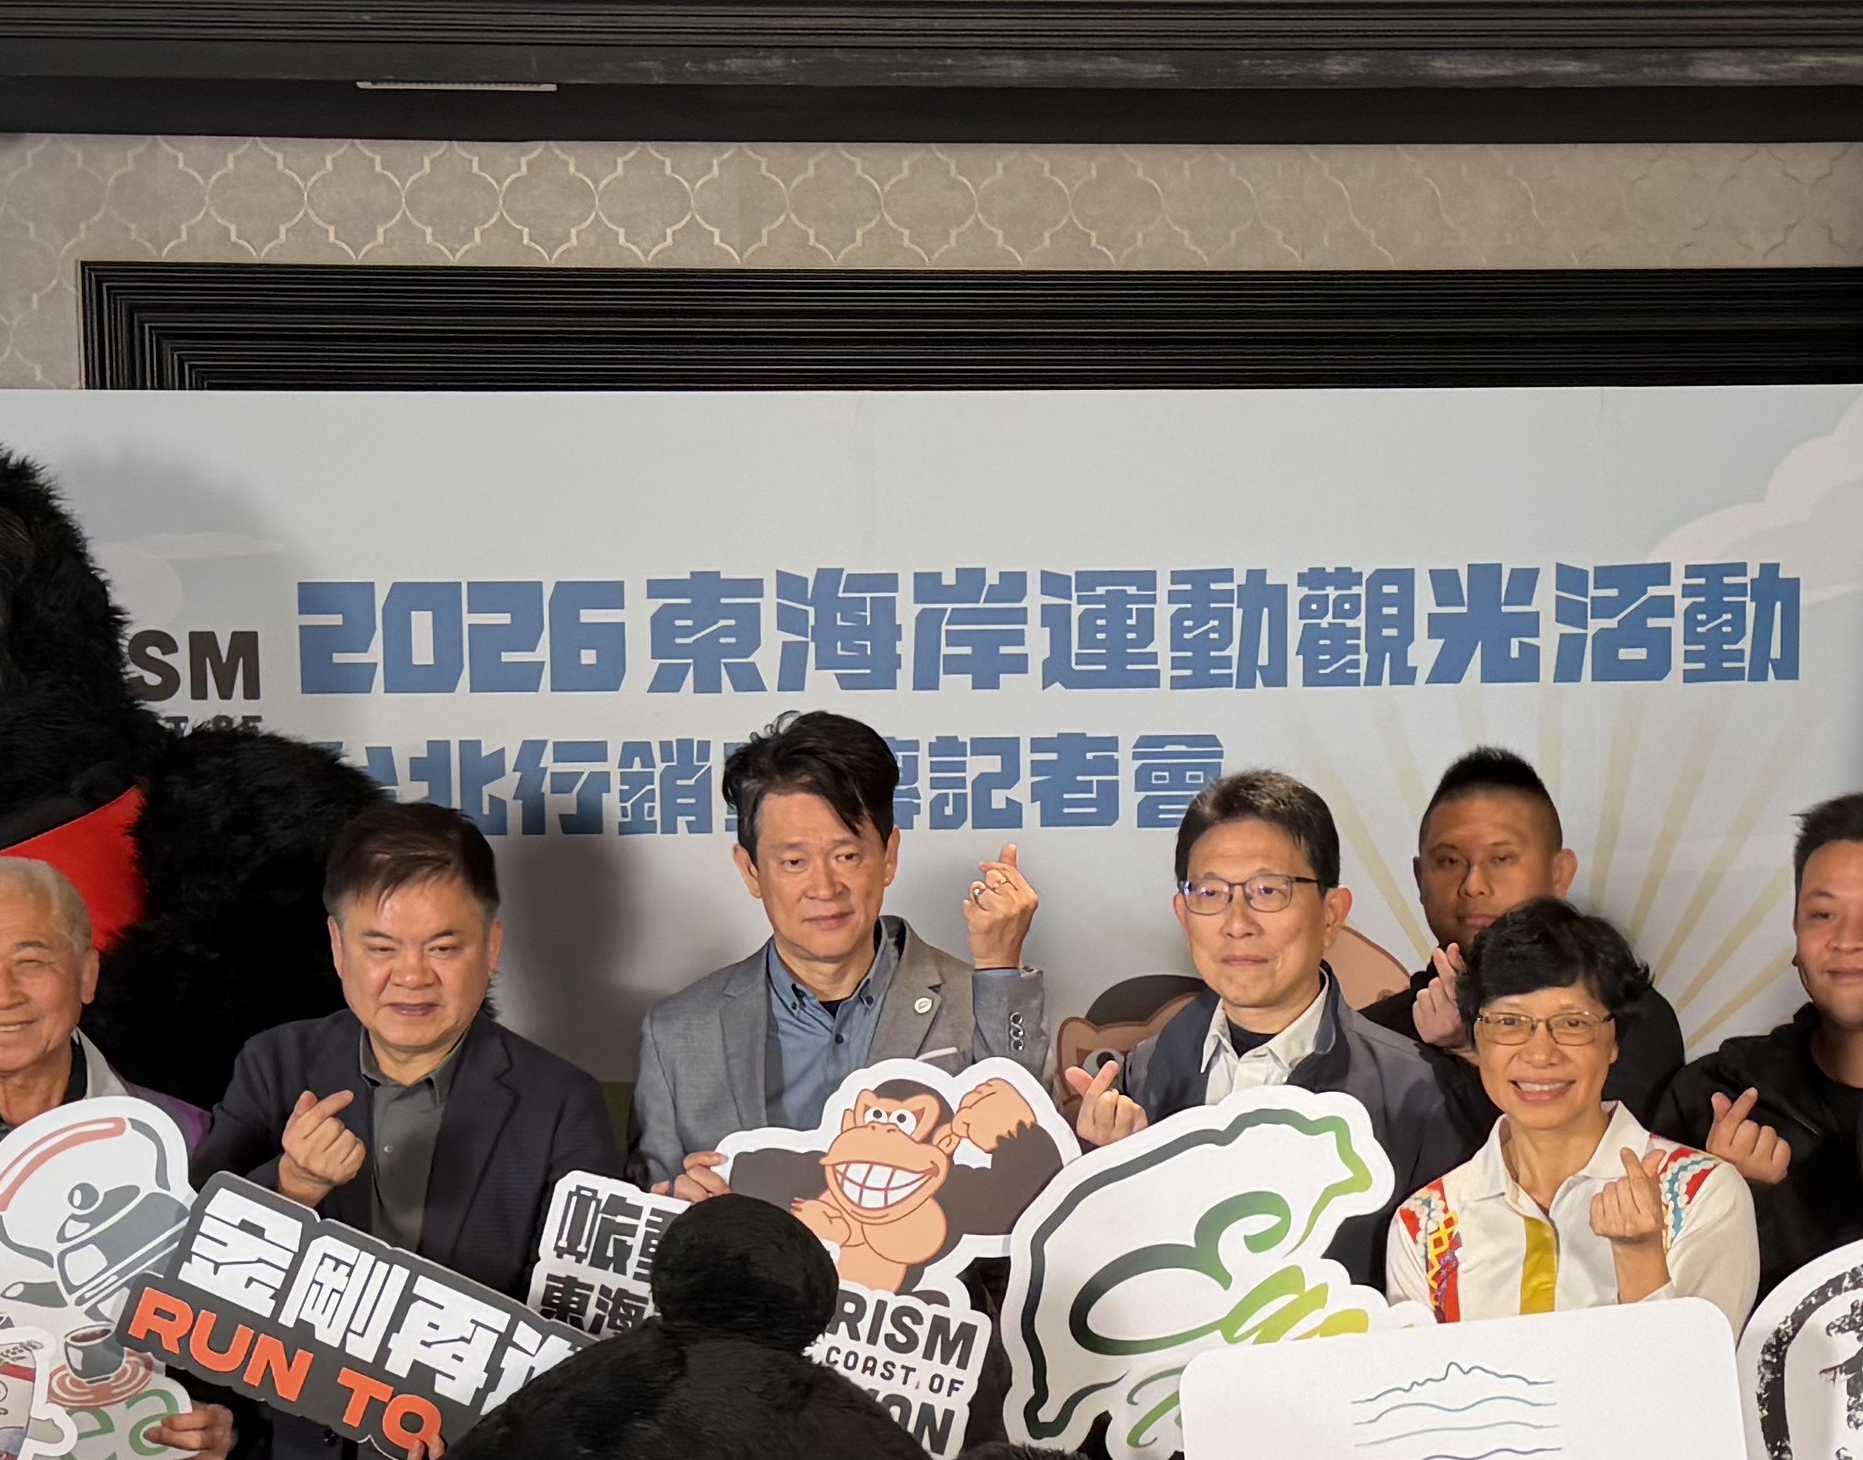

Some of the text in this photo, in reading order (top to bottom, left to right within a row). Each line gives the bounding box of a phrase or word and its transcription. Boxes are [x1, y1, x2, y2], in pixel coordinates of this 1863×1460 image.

[297, 562, 1800, 694] 2026東海岸運動觀光活動
[313, 732, 1225, 836] 北行銷記者會
[540, 1273, 650, 1337] 東海
[836, 1290, 979, 1371] RISM
[128, 1286, 442, 1452] RUN TO
[825, 1346, 964, 1398] COAST OF
